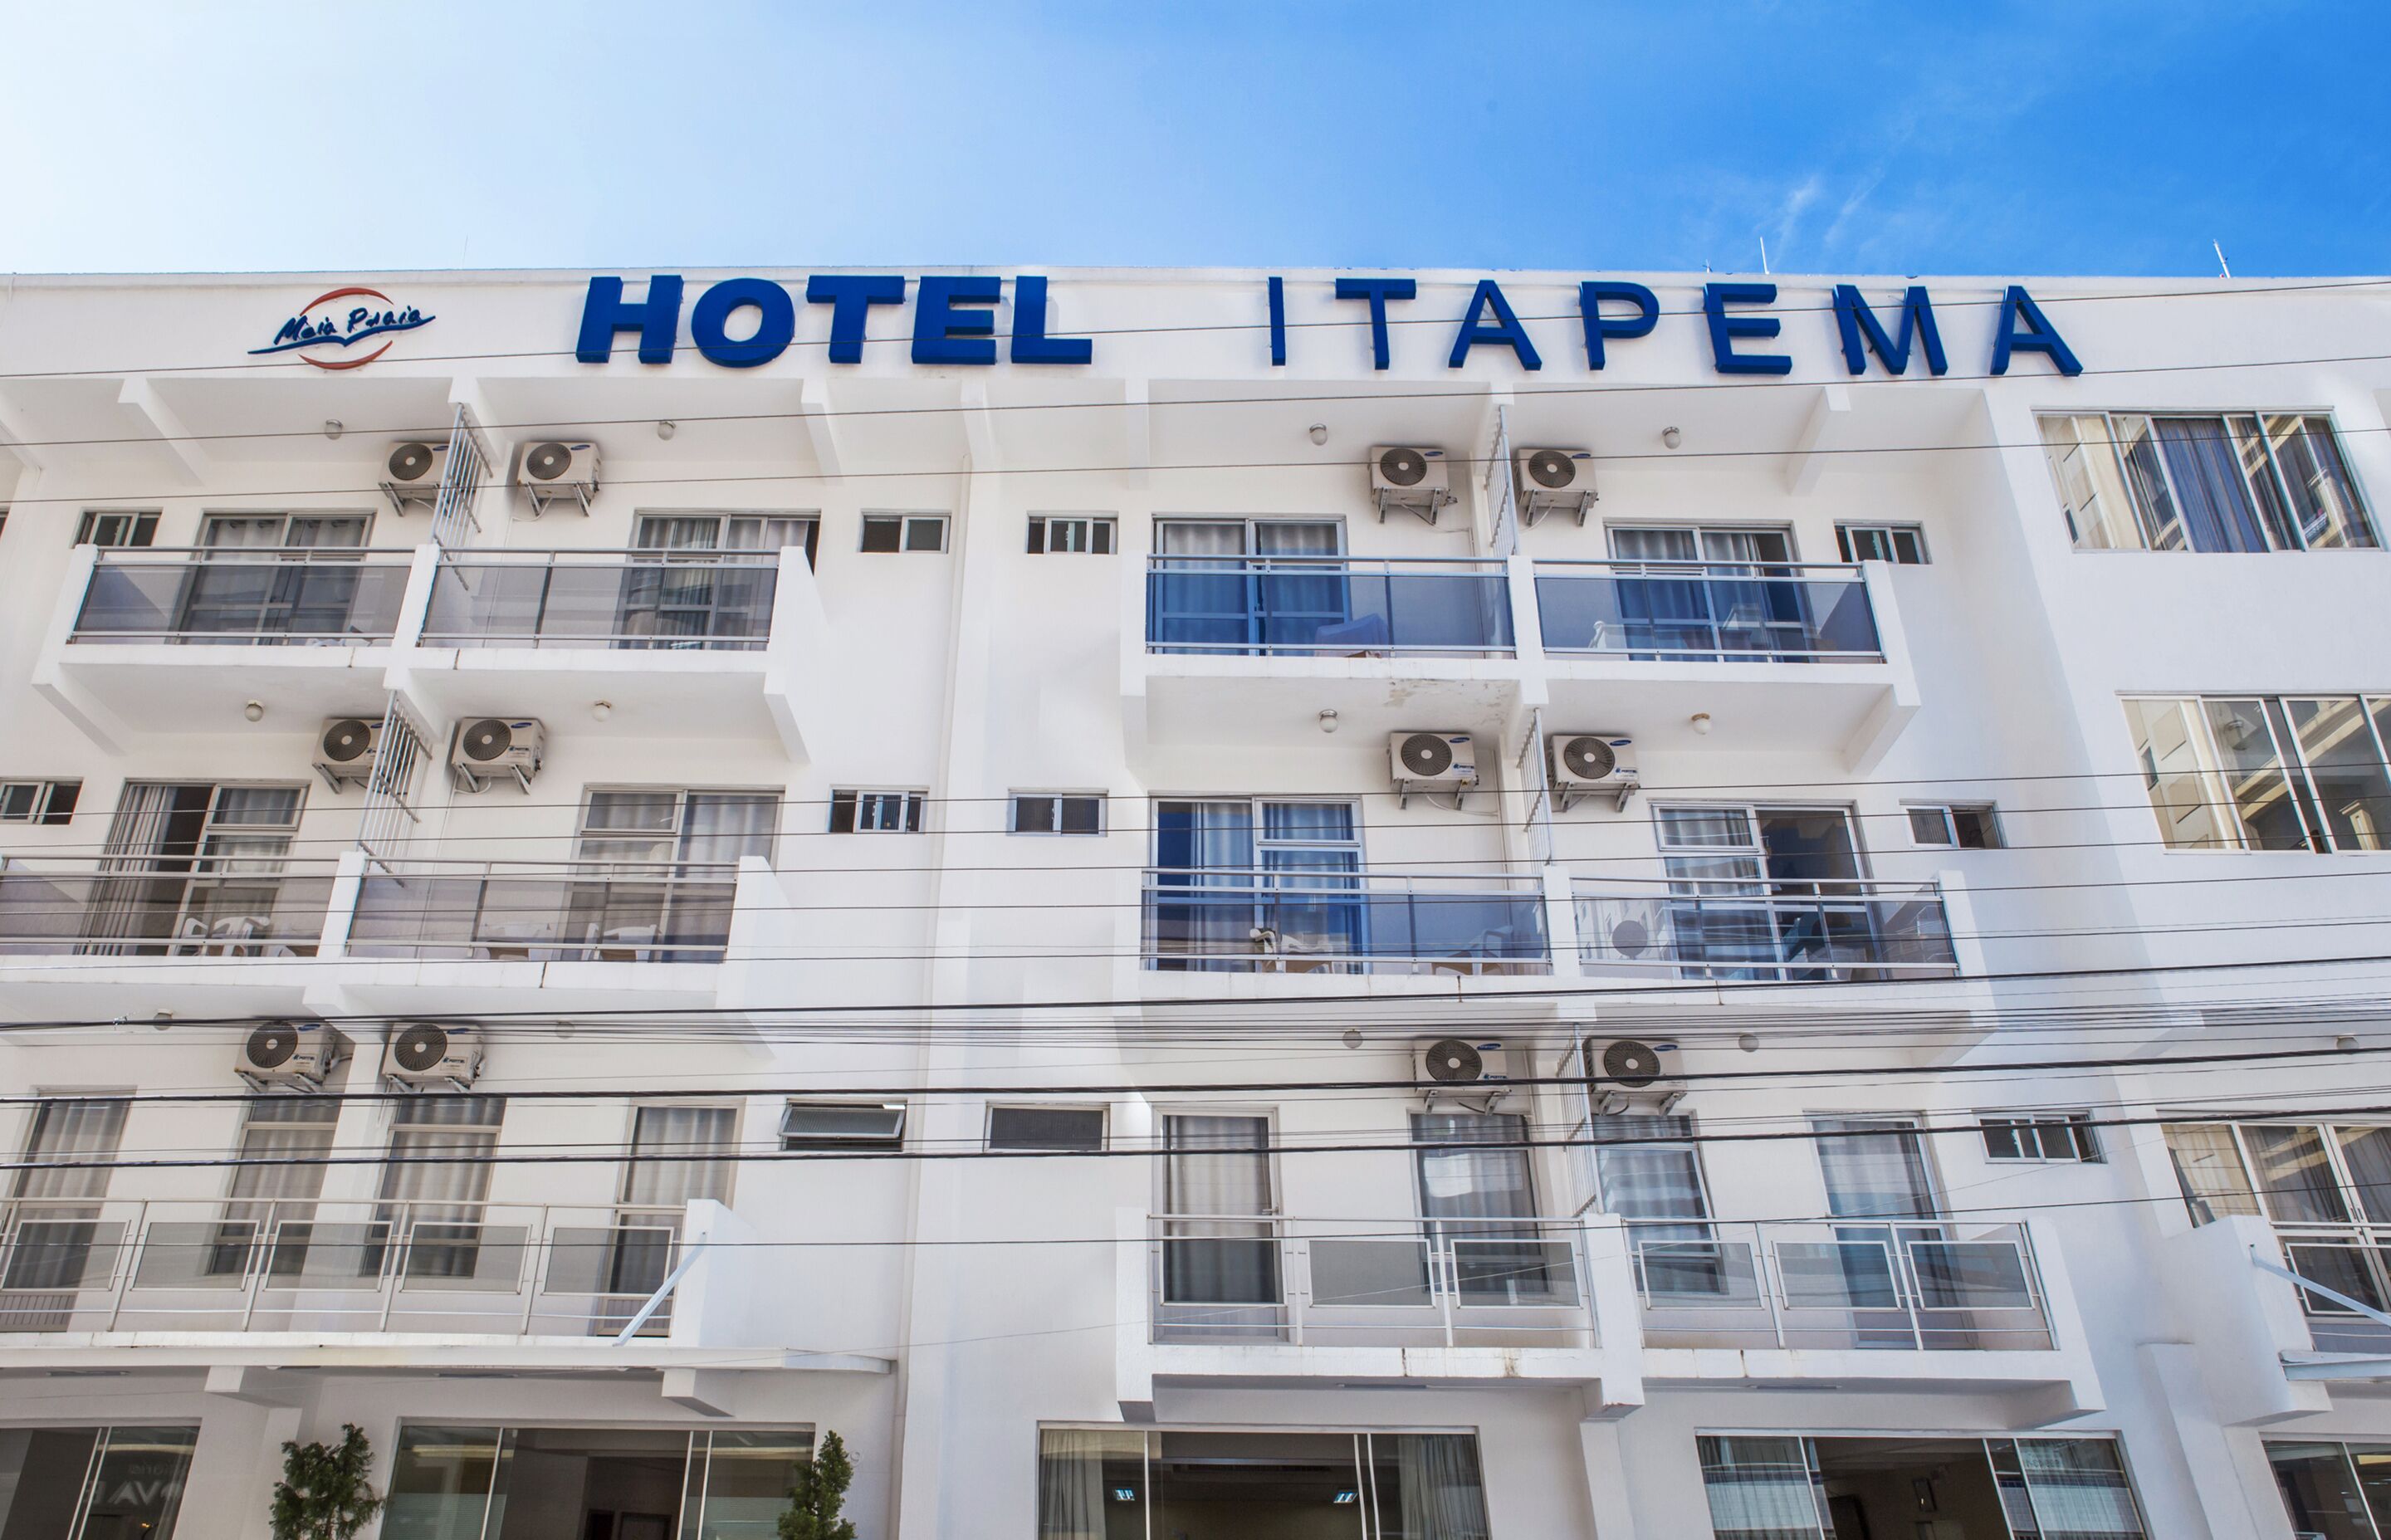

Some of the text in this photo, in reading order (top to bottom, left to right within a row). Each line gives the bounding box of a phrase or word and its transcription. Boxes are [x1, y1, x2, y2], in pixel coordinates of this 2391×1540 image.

[273, 305, 422, 345] Meia Praia
[576, 275, 2084, 375] HOTEL ITAPEMA
